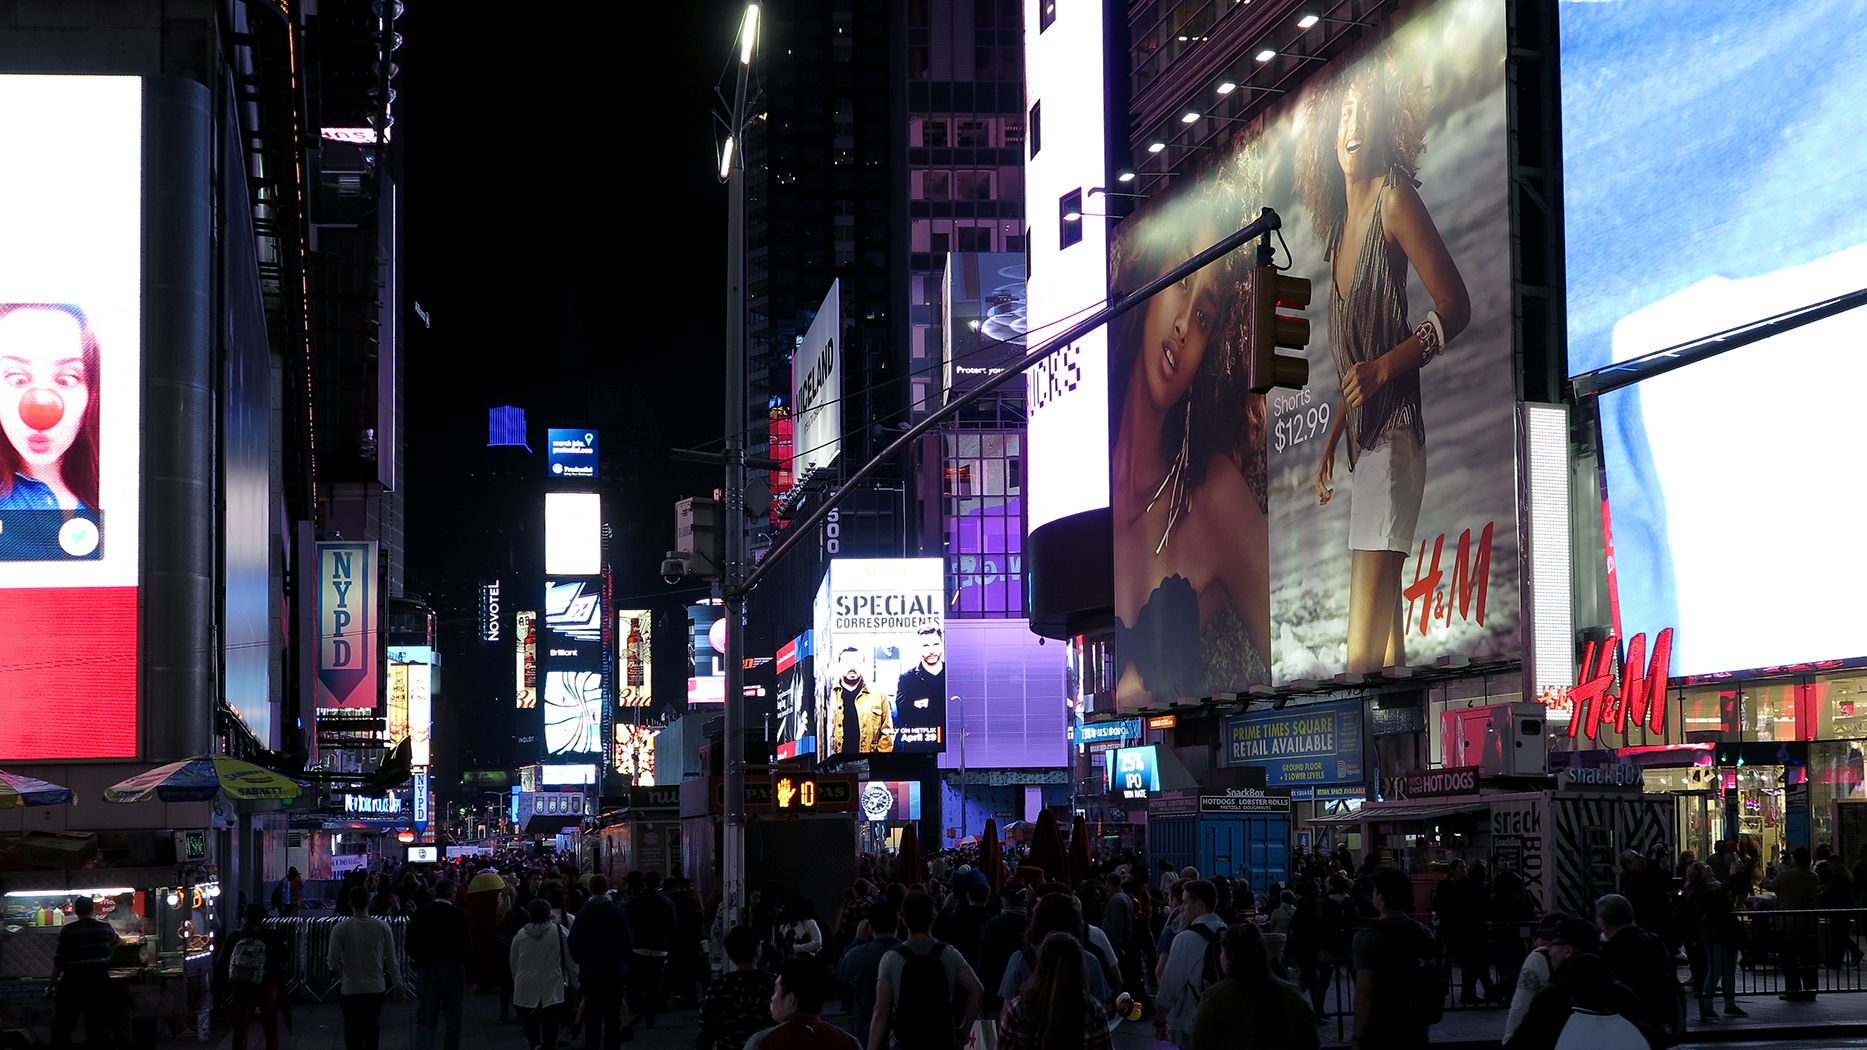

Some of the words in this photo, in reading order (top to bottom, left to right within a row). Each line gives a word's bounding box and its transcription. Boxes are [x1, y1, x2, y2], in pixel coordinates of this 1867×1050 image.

[796, 338, 834, 423] VICELAND
[956, 365, 987, 374] Protect
[1273, 388, 1311, 418] Shorts
[1274, 402, 1331, 454] $12.99
[1403, 521, 1494, 636] H&M
[332, 552, 353, 667] NYPD
[487, 579, 500, 642] NOVOTEL
[836, 616, 940, 629] CORRESPONDENTS
[1566, 627, 1673, 740] H&M
[925, 733, 937, 742] 29
[1233, 726, 1261, 741] PRIME
[1263, 722, 1290, 738] TIMES
[1293, 717, 1333, 735] SQUARE
[1233, 740, 1268, 758] RETAIL
[1272, 733, 1333, 754] AVAILABLE
[1119, 752, 1145, 773] 25%
[1282, 763, 1304, 772] GROUND
[1304, 762, 1322, 771] FLOOR
[1125, 773, 1142, 789] IPO
[1307, 771, 1325, 779] LEVELS
[1423, 775, 1443, 792] HOT
[1444, 772, 1474, 791] DOGS
[238, 787, 283, 796] SABRETT
[416, 775, 425, 820] NYPD
[800, 780, 815, 807] 10
[1226, 788, 1265, 797] SnackBox
[1344, 787, 1366, 795] AVAILABLE
[1409, 785, 1423, 794] best
[1268, 798, 1289, 806] ROLLS
[1493, 802, 1541, 834] snack
[1523, 836, 1543, 887] BOX
